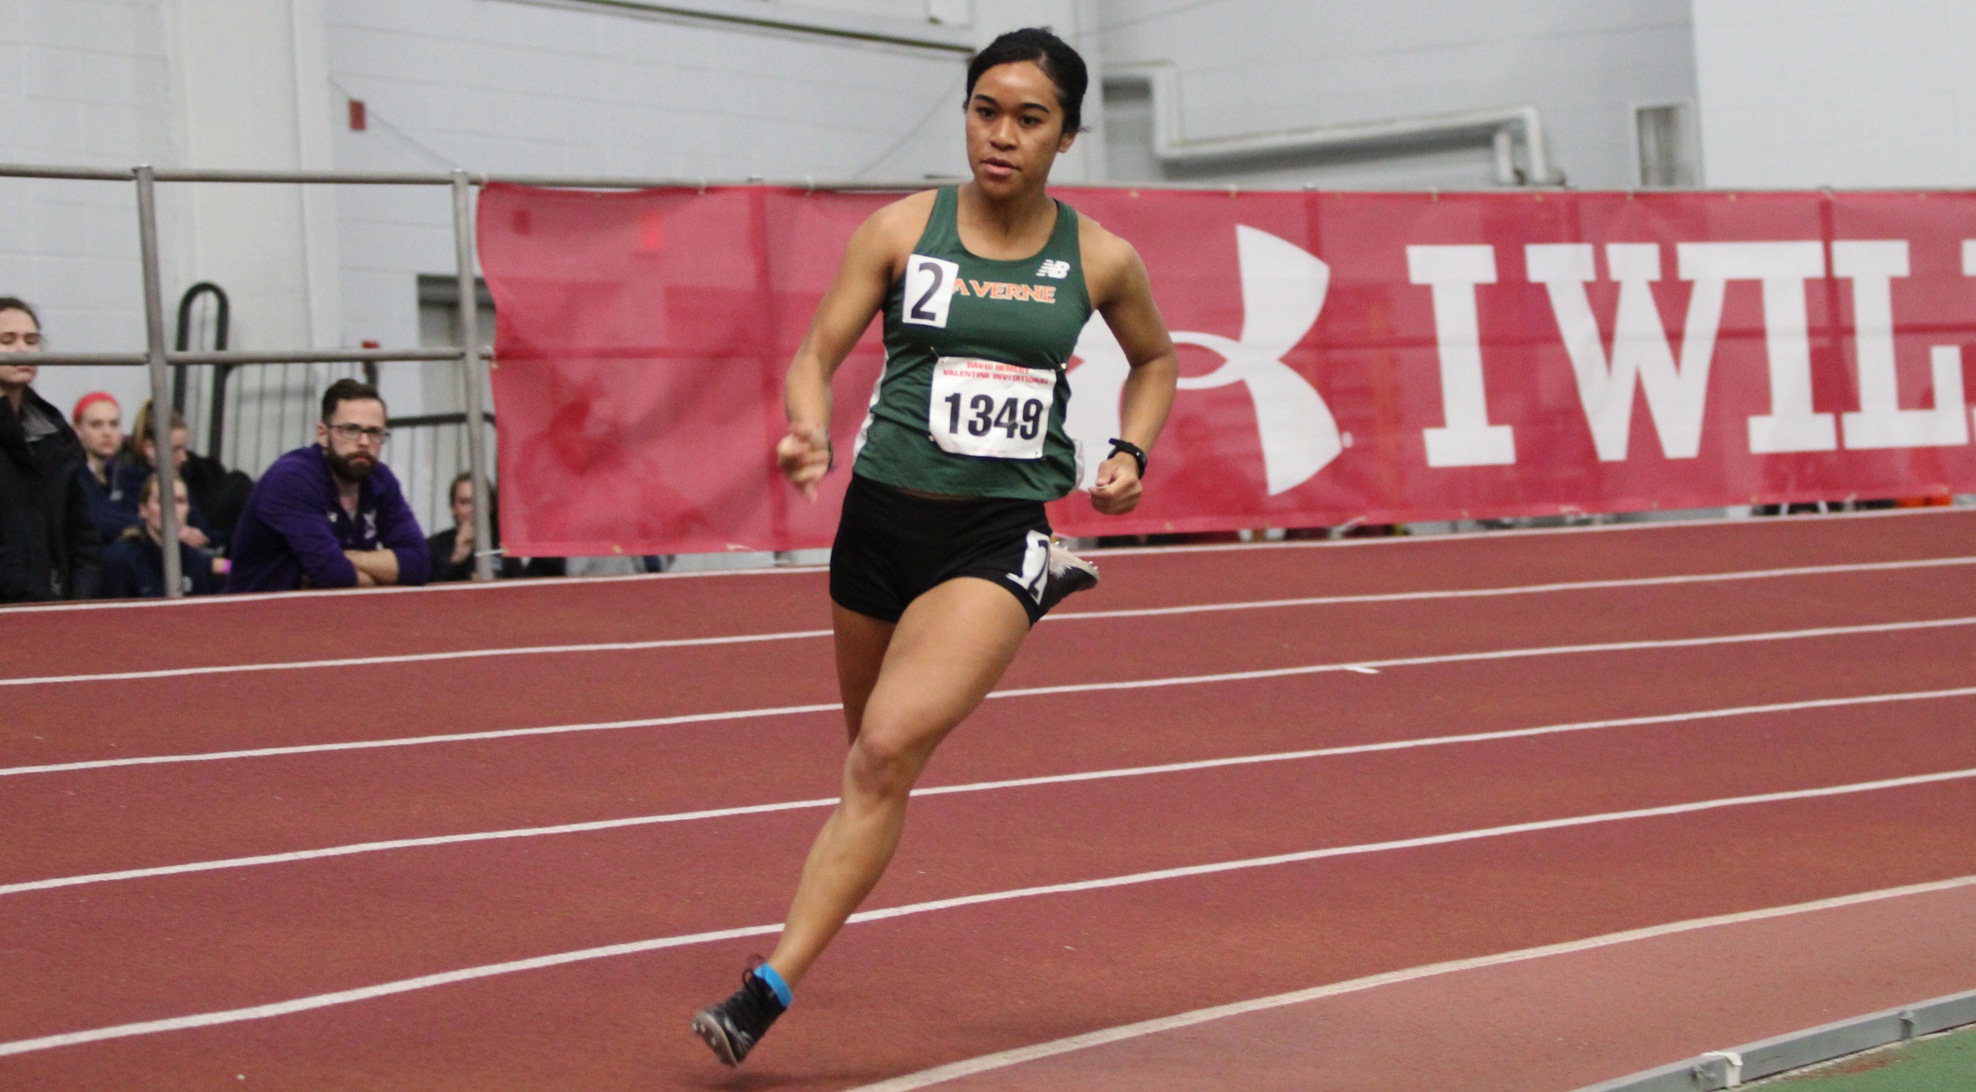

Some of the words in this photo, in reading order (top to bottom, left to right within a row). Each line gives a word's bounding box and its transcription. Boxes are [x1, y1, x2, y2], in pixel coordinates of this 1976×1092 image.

[910, 261, 943, 322] 2
[943, 369, 990, 379] VALENTINE
[992, 372, 1049, 385] INVITATIONAL
[967, 361, 993, 371] DAVID
[1406, 243, 1516, 468] I
[1524, 239, 1976, 461] WIL
[944, 392, 1044, 441] 1349
